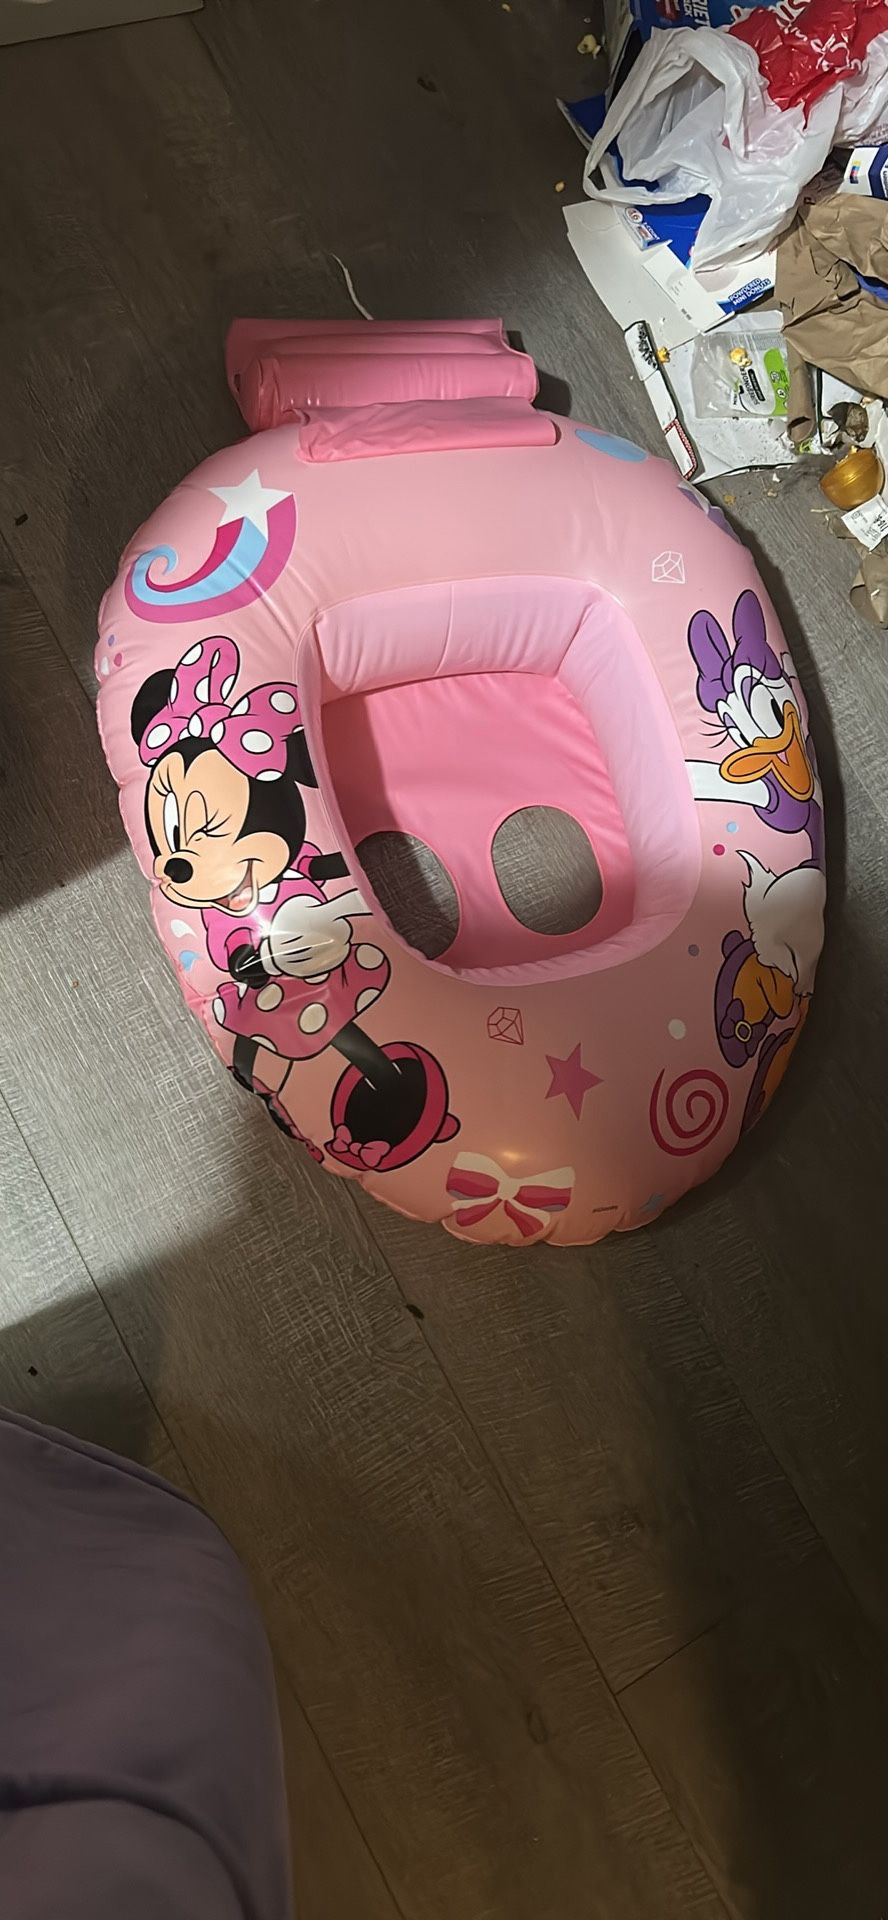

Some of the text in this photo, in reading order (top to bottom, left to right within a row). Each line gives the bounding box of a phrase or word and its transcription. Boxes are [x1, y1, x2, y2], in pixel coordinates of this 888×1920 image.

[730, 279, 761, 301] POWDERED
[732, 279, 771, 306] MINI DONUTS
